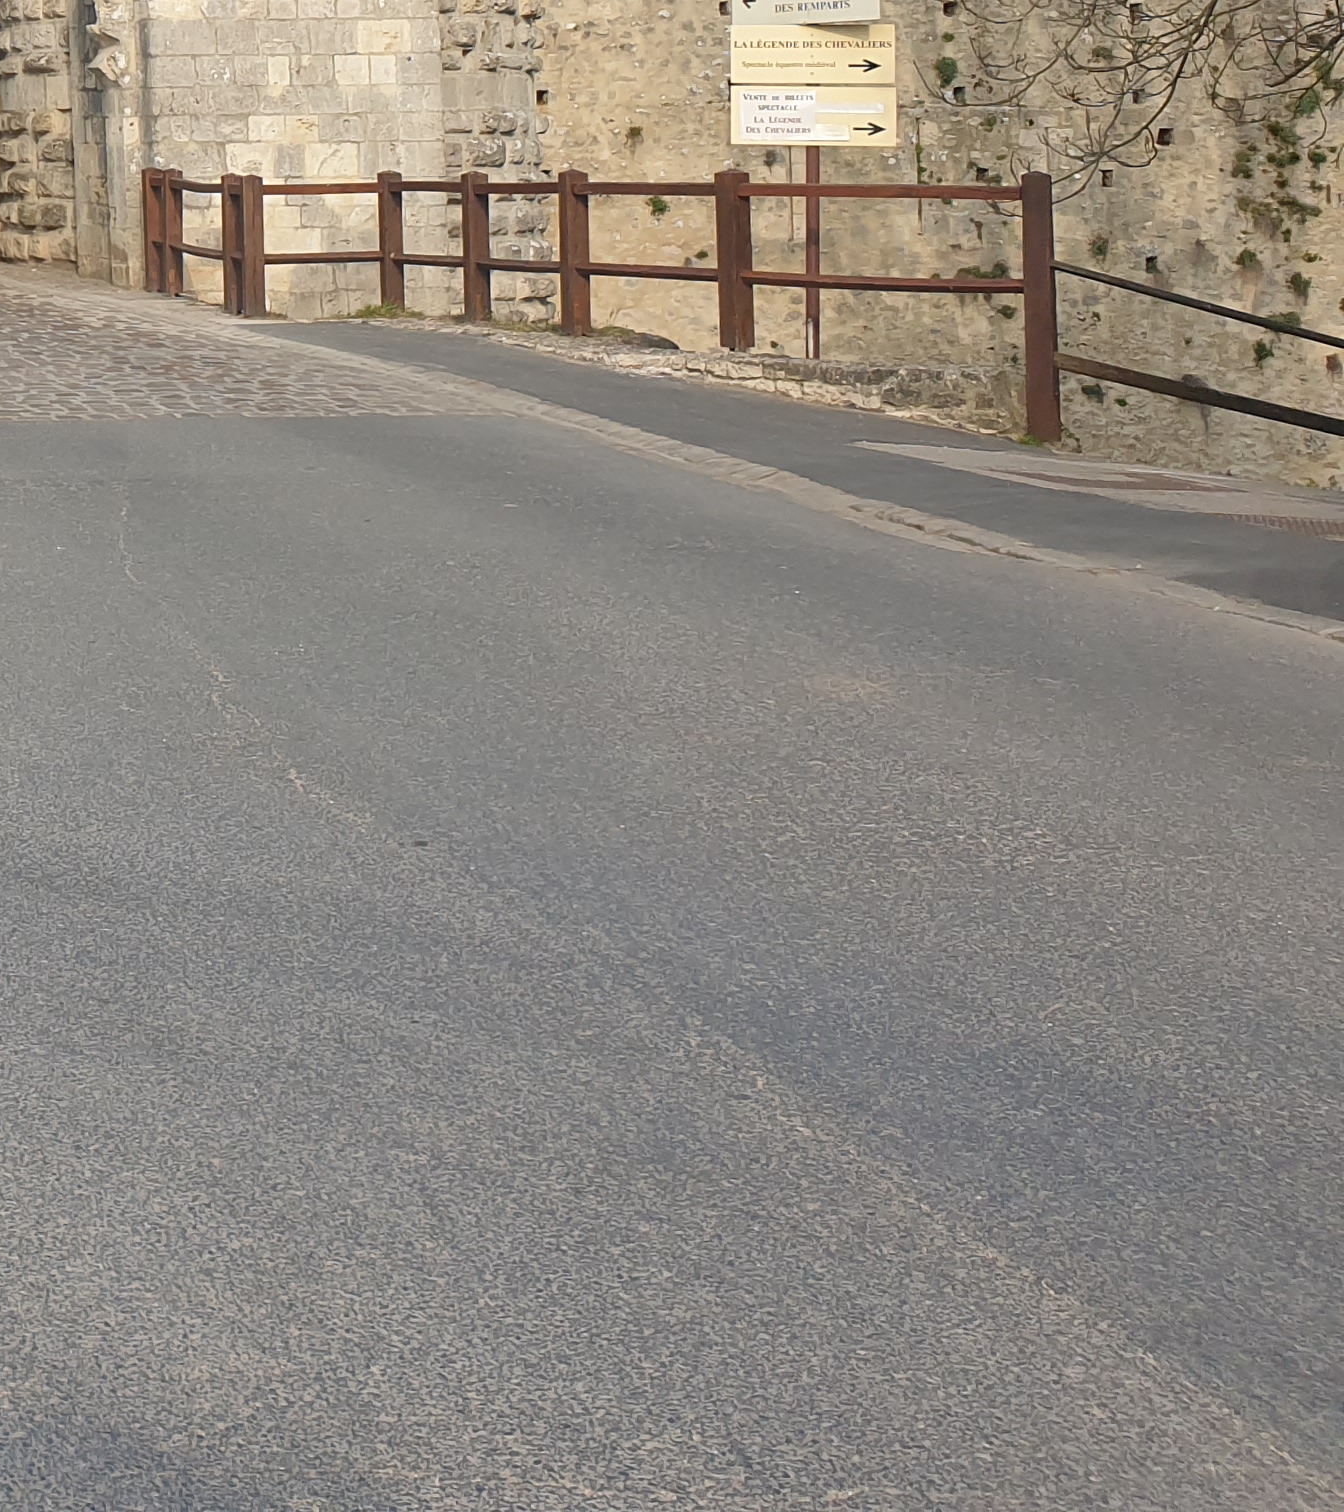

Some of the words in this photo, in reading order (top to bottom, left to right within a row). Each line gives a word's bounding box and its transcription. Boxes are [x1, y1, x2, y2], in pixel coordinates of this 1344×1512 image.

[775, 3, 794, 14] DES
[797, 0, 850, 12] REMPARTS
[733, 40, 748, 49] LA
[749, 38, 800, 49] LÉGENDE
[802, 40, 822, 49] DES
[824, 40, 893, 49] CHEVALIERS
